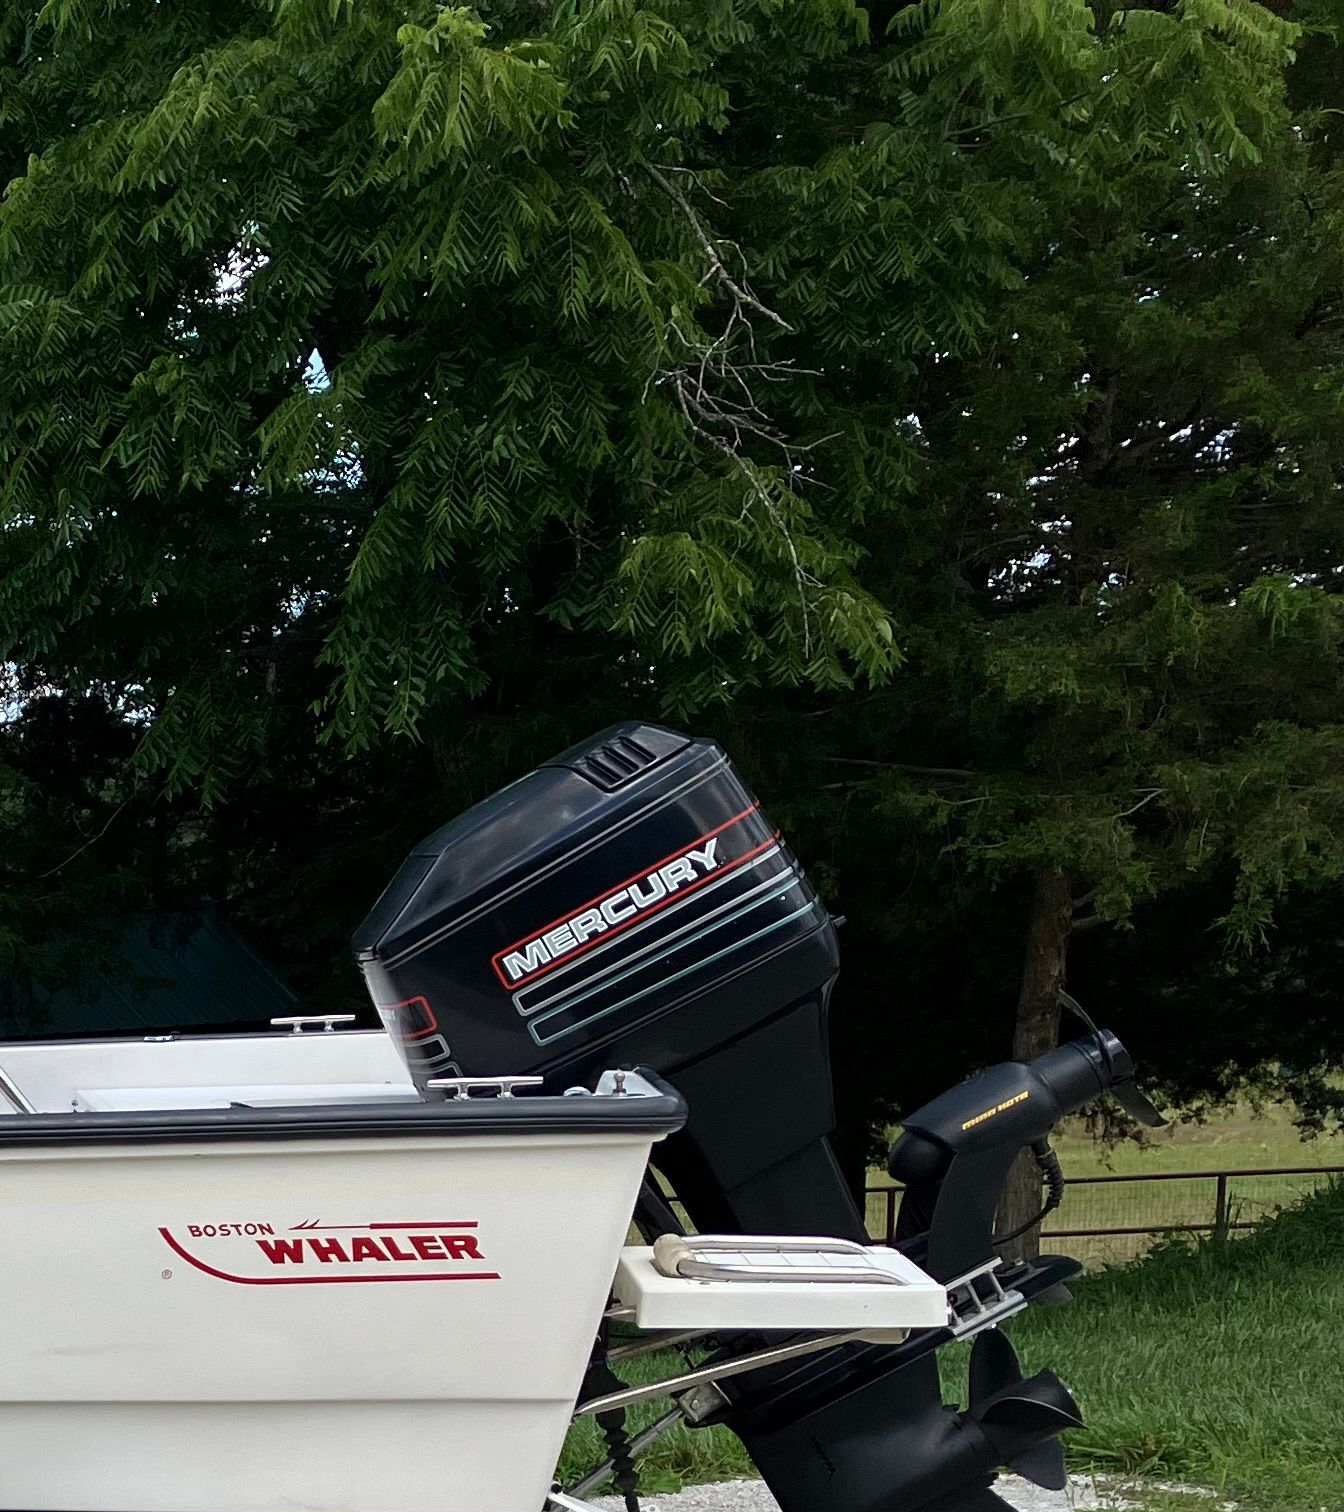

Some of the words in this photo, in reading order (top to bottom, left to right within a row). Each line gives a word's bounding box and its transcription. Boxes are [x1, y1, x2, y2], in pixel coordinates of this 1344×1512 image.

[502, 837, 719, 981] MERCURY
[187, 1222, 275, 1238] BOSTON
[255, 1234, 486, 1265] WHALER
